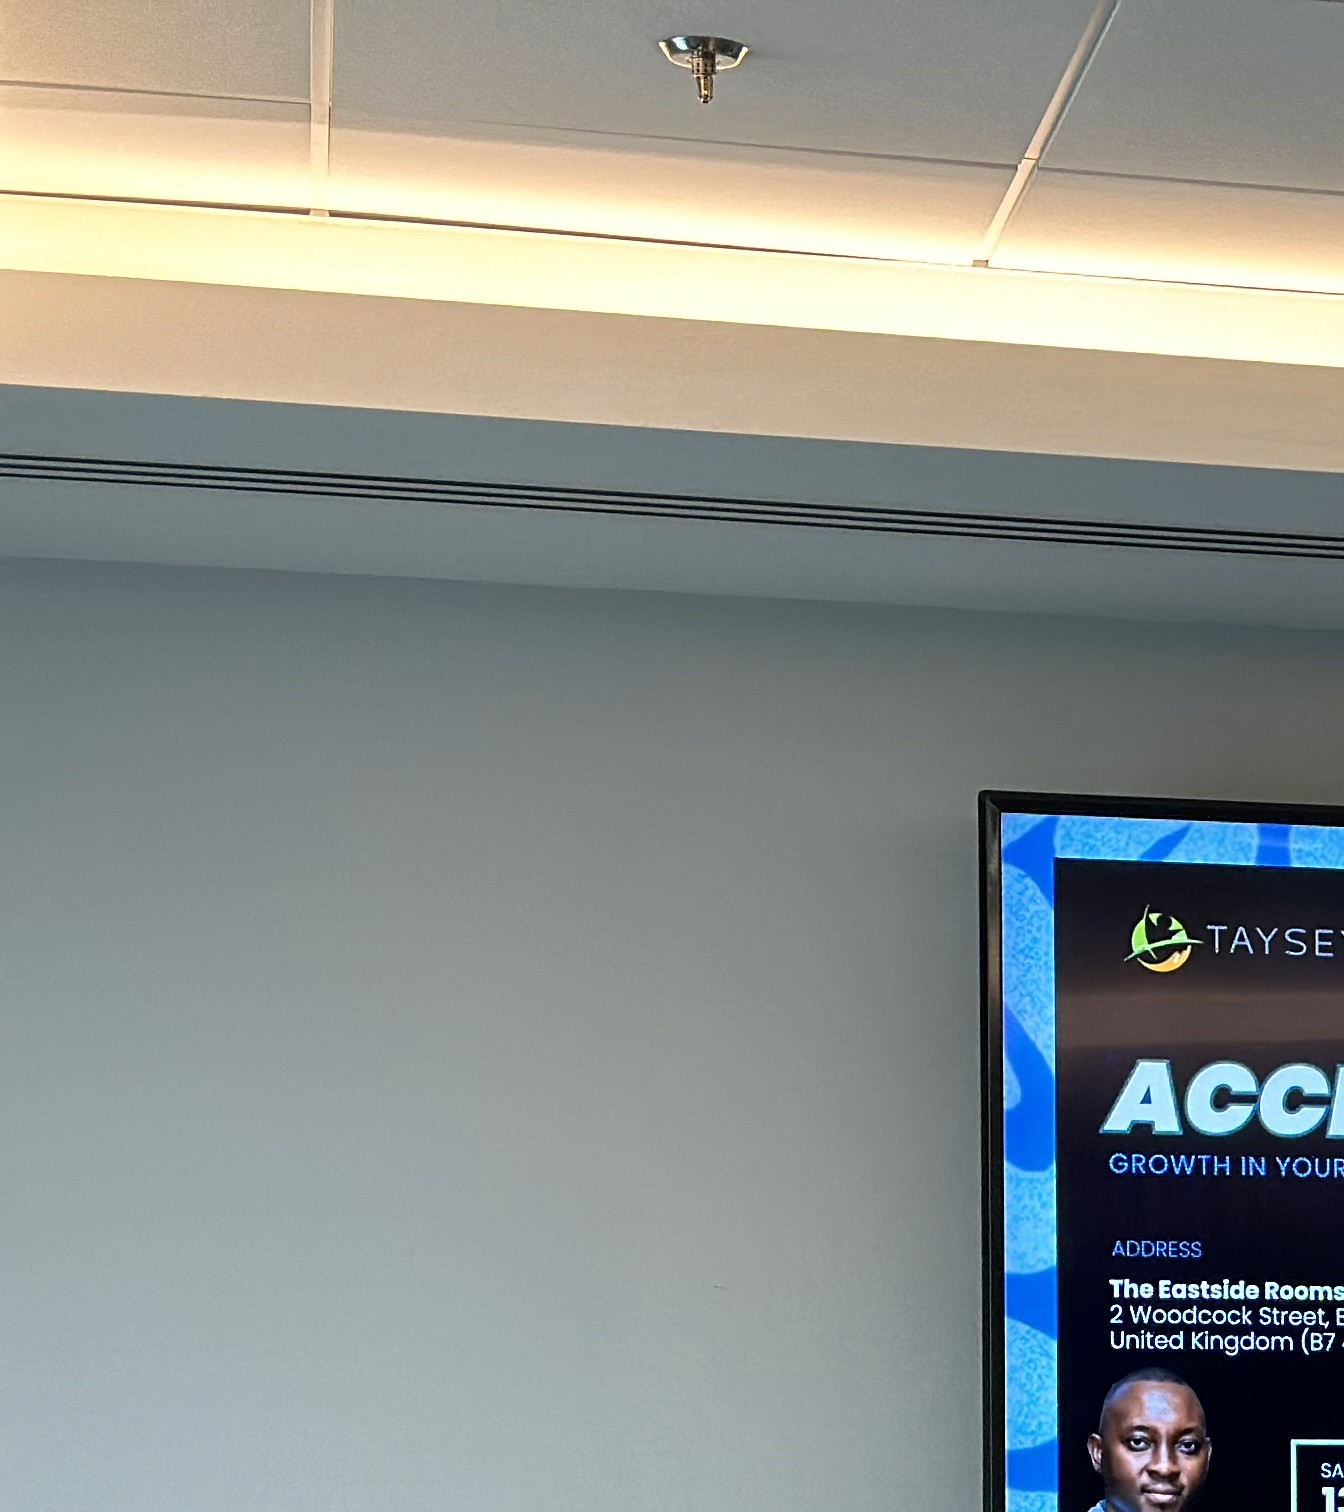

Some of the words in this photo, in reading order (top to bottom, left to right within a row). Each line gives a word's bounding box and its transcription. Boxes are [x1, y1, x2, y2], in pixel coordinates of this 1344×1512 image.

[1109, 1153, 1229, 1175] GROWTH
[1241, 1157, 1265, 1175] IN
[1112, 1241, 1201, 1257] ADDRESS
[1109, 1279, 1154, 1298] The
[1159, 1279, 1259, 1299] Eastside
[1110, 1304, 1123, 1323] 2
[1130, 1305, 1252, 1325] Woodcock
[1259, 1307, 1330, 1329] Street,
[1111, 1330, 1183, 1349] United
[1192, 1331, 1293, 1356] Kingdom
[1301, 1328, 1335, 1355] (B7
